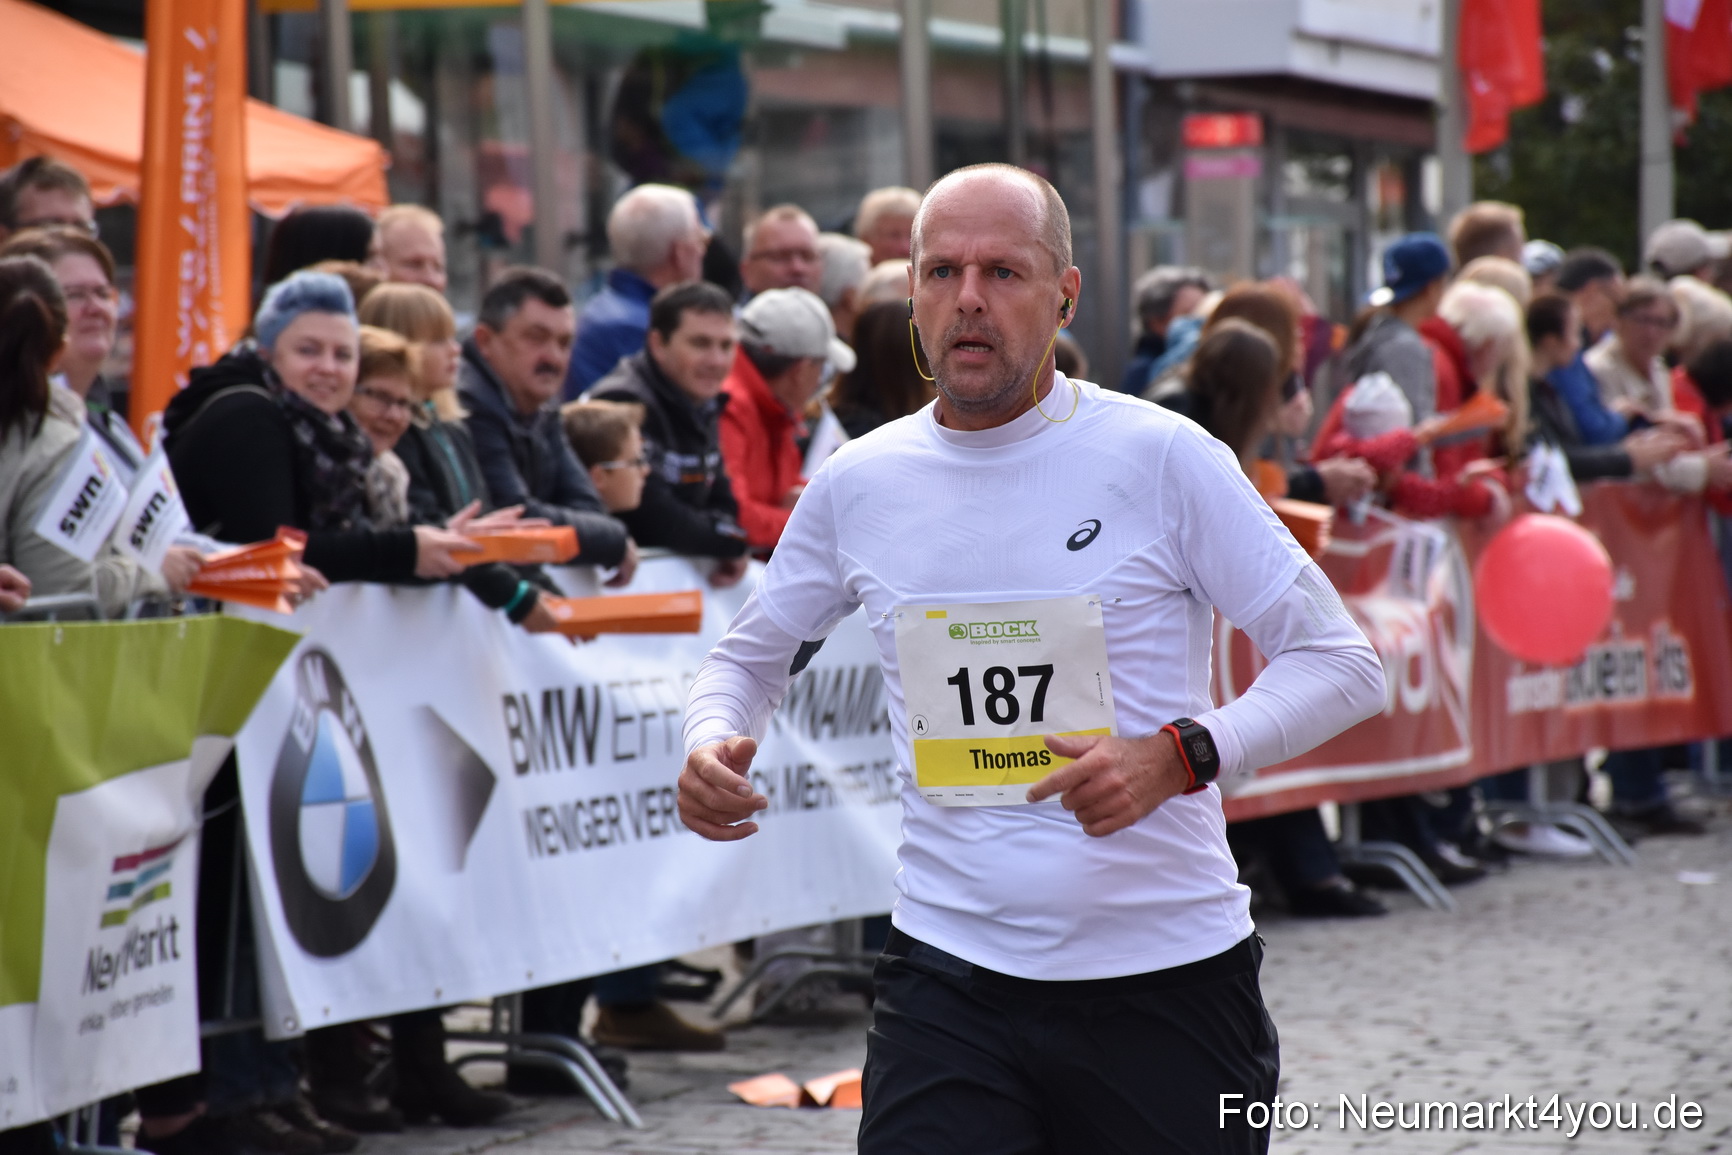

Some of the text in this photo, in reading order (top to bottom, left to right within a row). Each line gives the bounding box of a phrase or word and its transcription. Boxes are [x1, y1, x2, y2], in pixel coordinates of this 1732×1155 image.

[181, 63, 205, 204] PRINT
[59, 475, 103, 538] swn
[130, 491, 168, 552] swn
[969, 620, 1039, 639] BOCK
[916, 720, 924, 731] A
[947, 664, 1054, 726] 187
[502, 684, 601, 776] BMW
[969, 748, 1052, 770] Thomas
